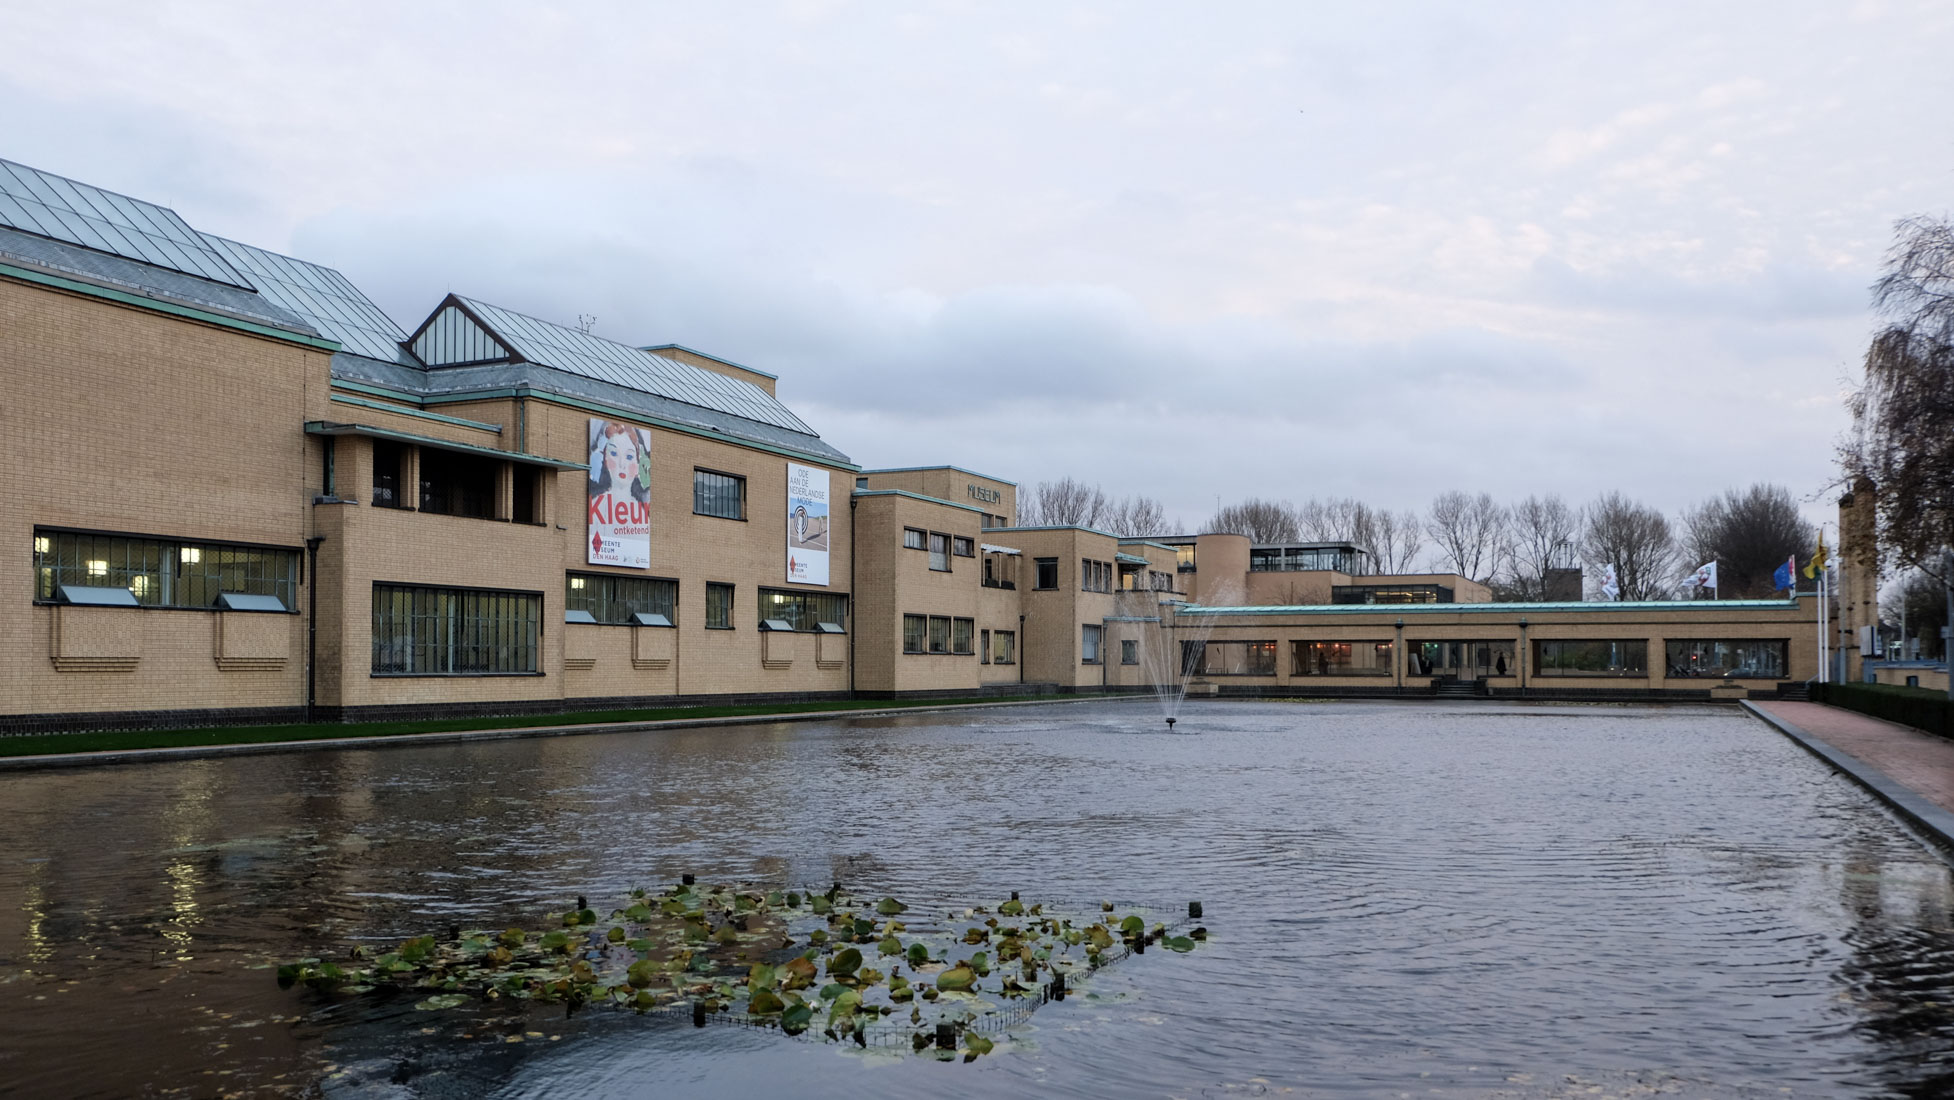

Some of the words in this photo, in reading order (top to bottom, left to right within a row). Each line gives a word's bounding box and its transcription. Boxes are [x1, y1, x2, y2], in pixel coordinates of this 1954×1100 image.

[798, 469, 809, 479] ODE
[790, 477, 801, 486] AAN
[802, 479, 809, 488] DE
[968, 484, 1000, 504] MUSEUM
[589, 494, 650, 524] Kleur
[614, 526, 649, 535] ontketend
